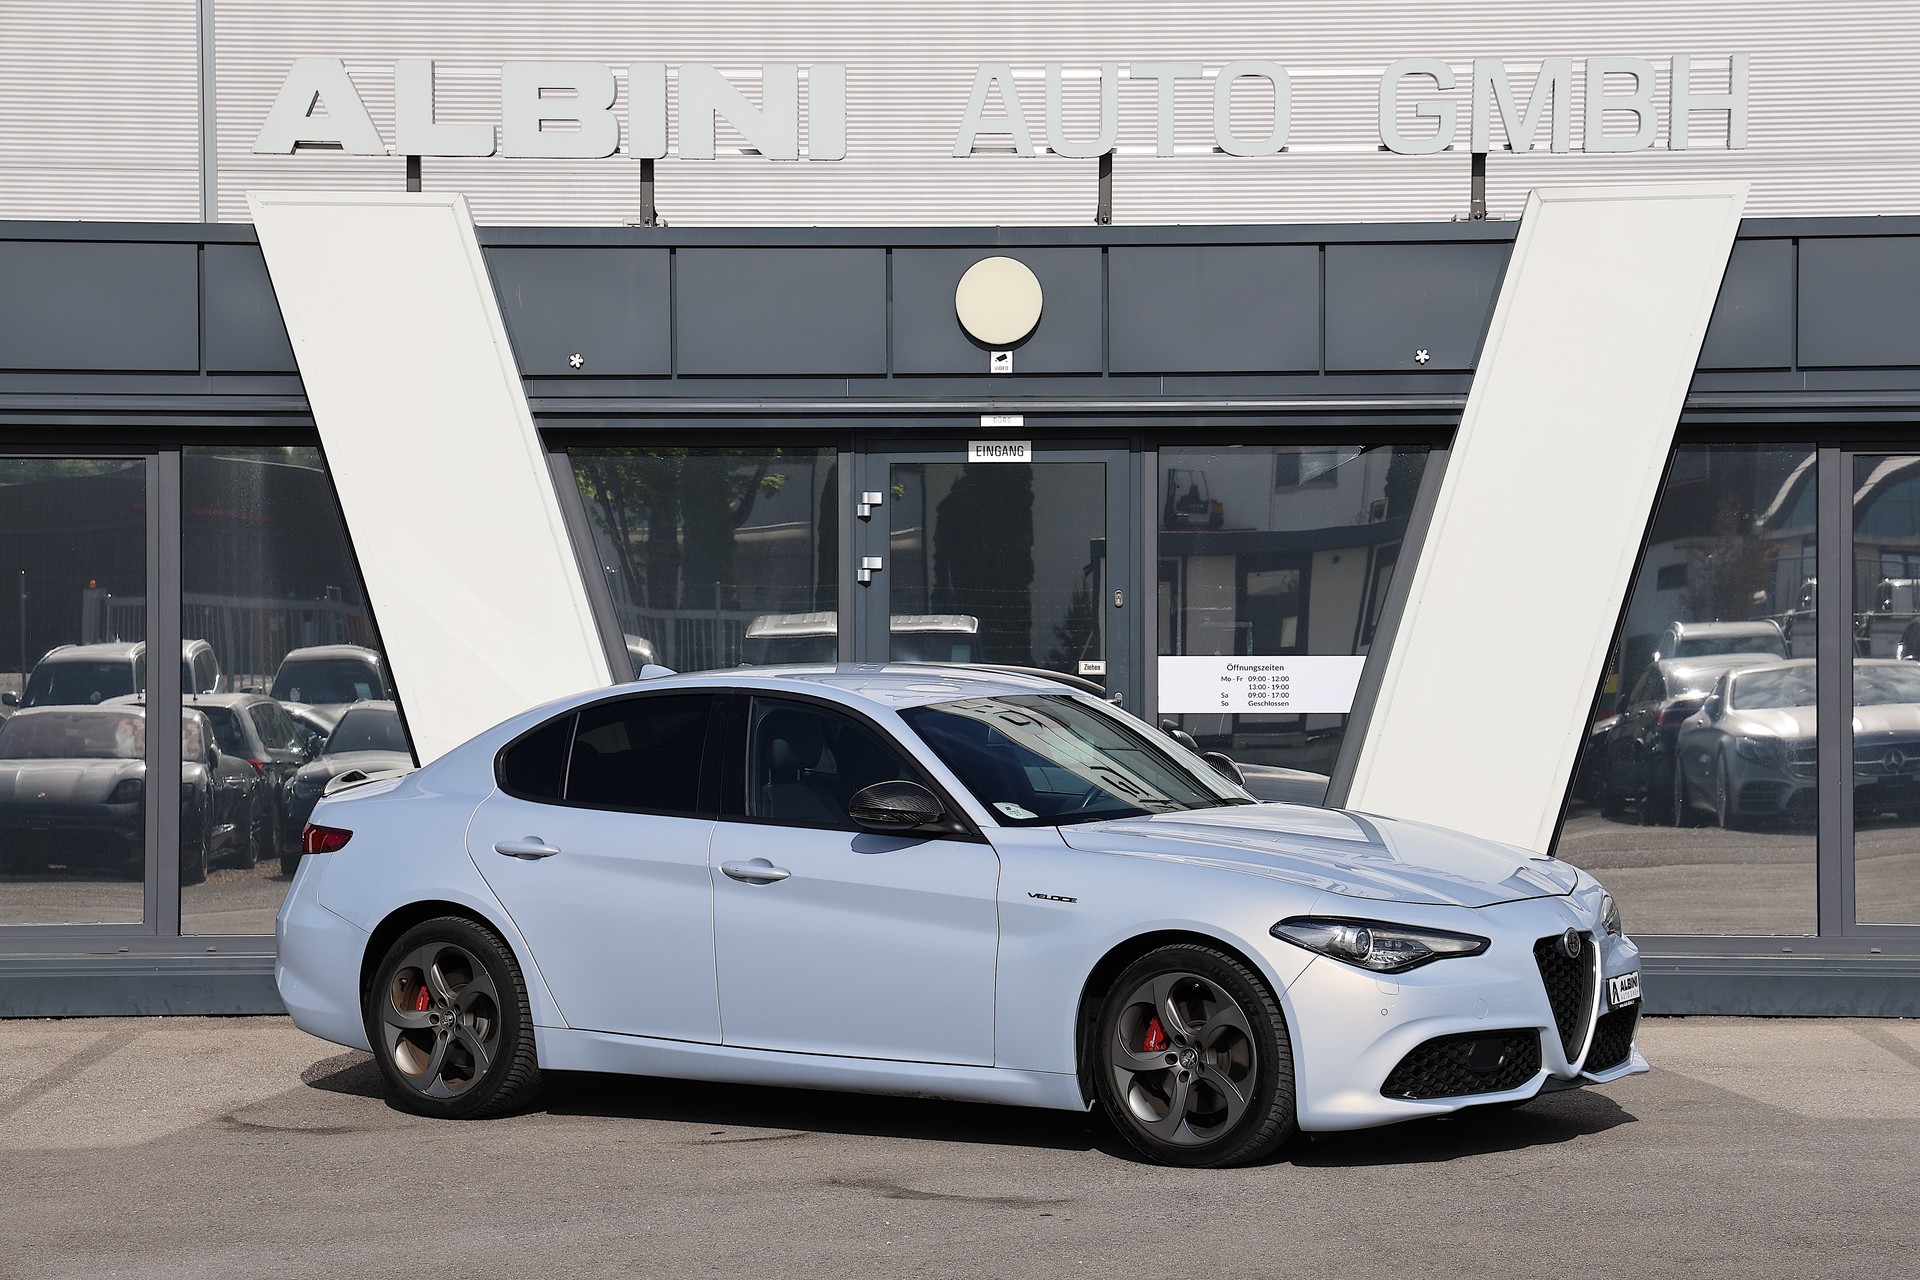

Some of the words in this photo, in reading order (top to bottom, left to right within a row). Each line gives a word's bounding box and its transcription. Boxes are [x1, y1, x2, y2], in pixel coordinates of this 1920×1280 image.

[252, 58, 847, 160] ALBINI
[952, 60, 1292, 158] AUTO
[1379, 52, 1752, 156] GMBH
[976, 445, 1024, 457] EINGANG
[1083, 663, 1101, 671] Ziehen
[1226, 663, 1285, 672] Öffnungszeiten
[1027, 892, 1078, 903] VELOCE
